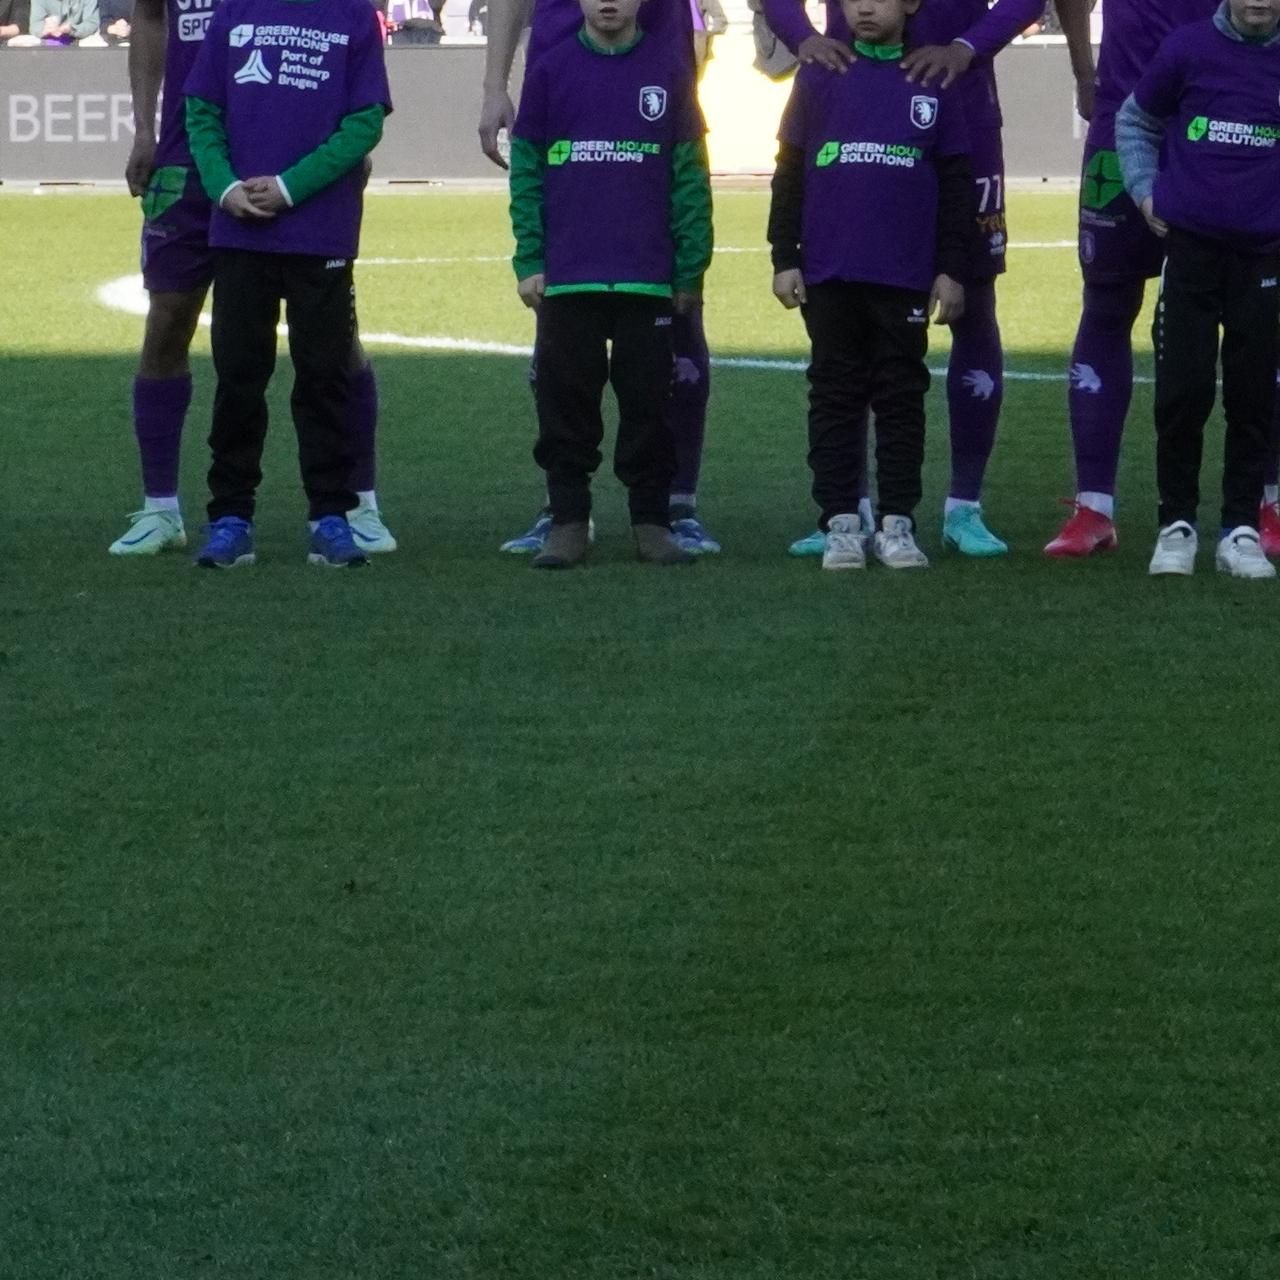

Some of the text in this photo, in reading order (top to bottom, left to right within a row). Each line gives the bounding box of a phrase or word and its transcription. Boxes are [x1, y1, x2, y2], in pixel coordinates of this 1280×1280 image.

[181, 19, 210, 35] SPO
[254, 34, 330, 52] SOLUTIONS
[256, 25, 349, 46] GREEN HOUSE
[281, 49, 324, 66] Port of
[279, 61, 330, 81] Antwerp
[278, 74, 319, 90] Bruges
[8, 94, 137, 142] BEER
[1208, 120, 1254, 134] GREEN
[571, 141, 614, 152] GREEN
[840, 142, 885, 153] GREEN
[1208, 132, 1277, 147] SOLUTIONS
[570, 151, 643, 163] SOLUTIONS
[839, 153, 914, 167] SOLUTIONS
